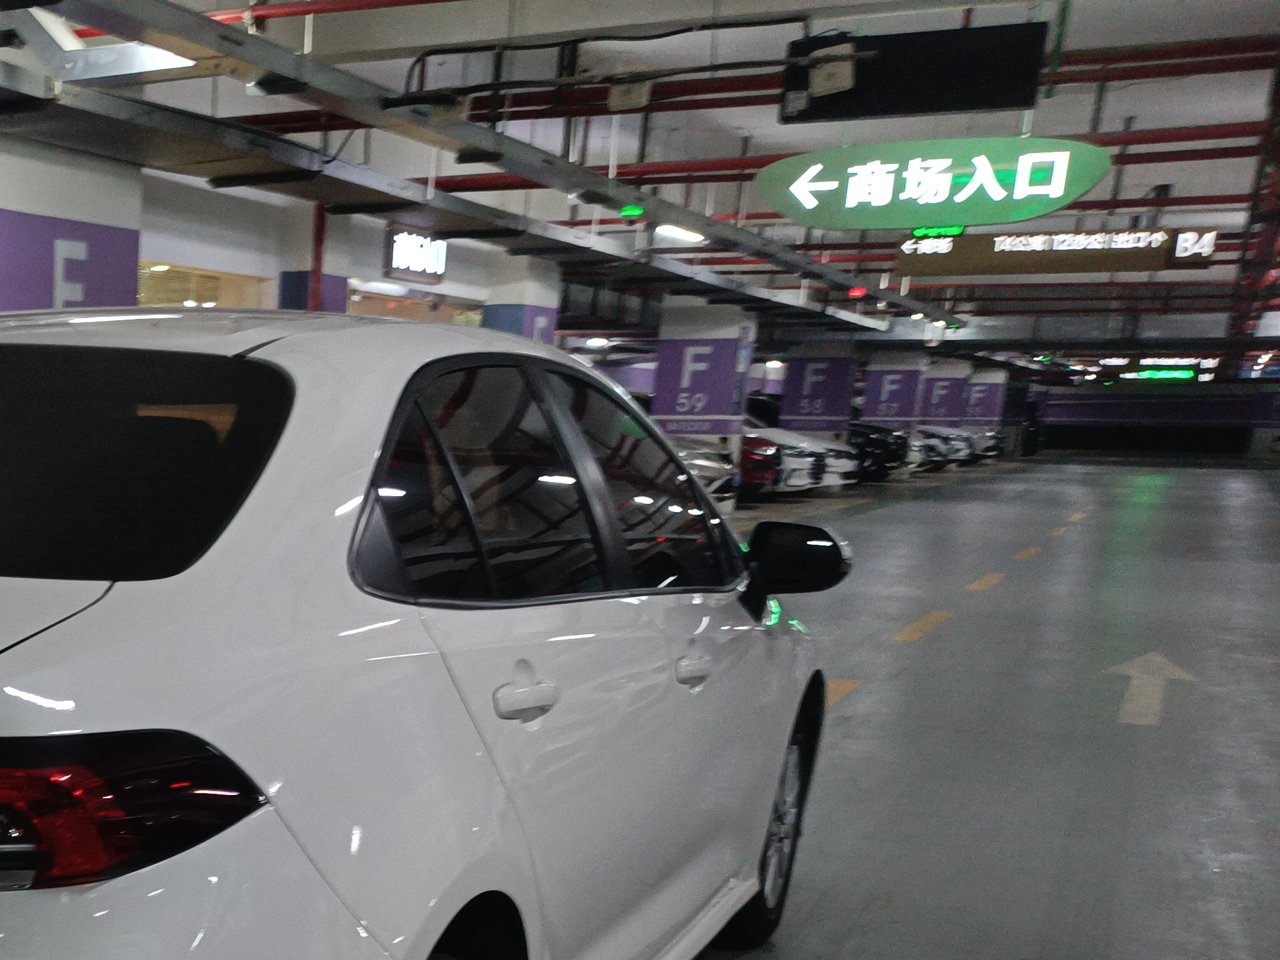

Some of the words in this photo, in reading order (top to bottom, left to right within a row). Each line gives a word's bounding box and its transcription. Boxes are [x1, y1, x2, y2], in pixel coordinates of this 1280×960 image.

[845, 151, 1070, 208] 商场入口
[1175, 231, 1218, 257] B4
[53, 239, 89, 310] F
[680, 346, 714, 388] F
[803, 362, 829, 395] F
[675, 393, 707, 412] 59
[880, 375, 903, 401] F
[931, 381, 951, 404] F
